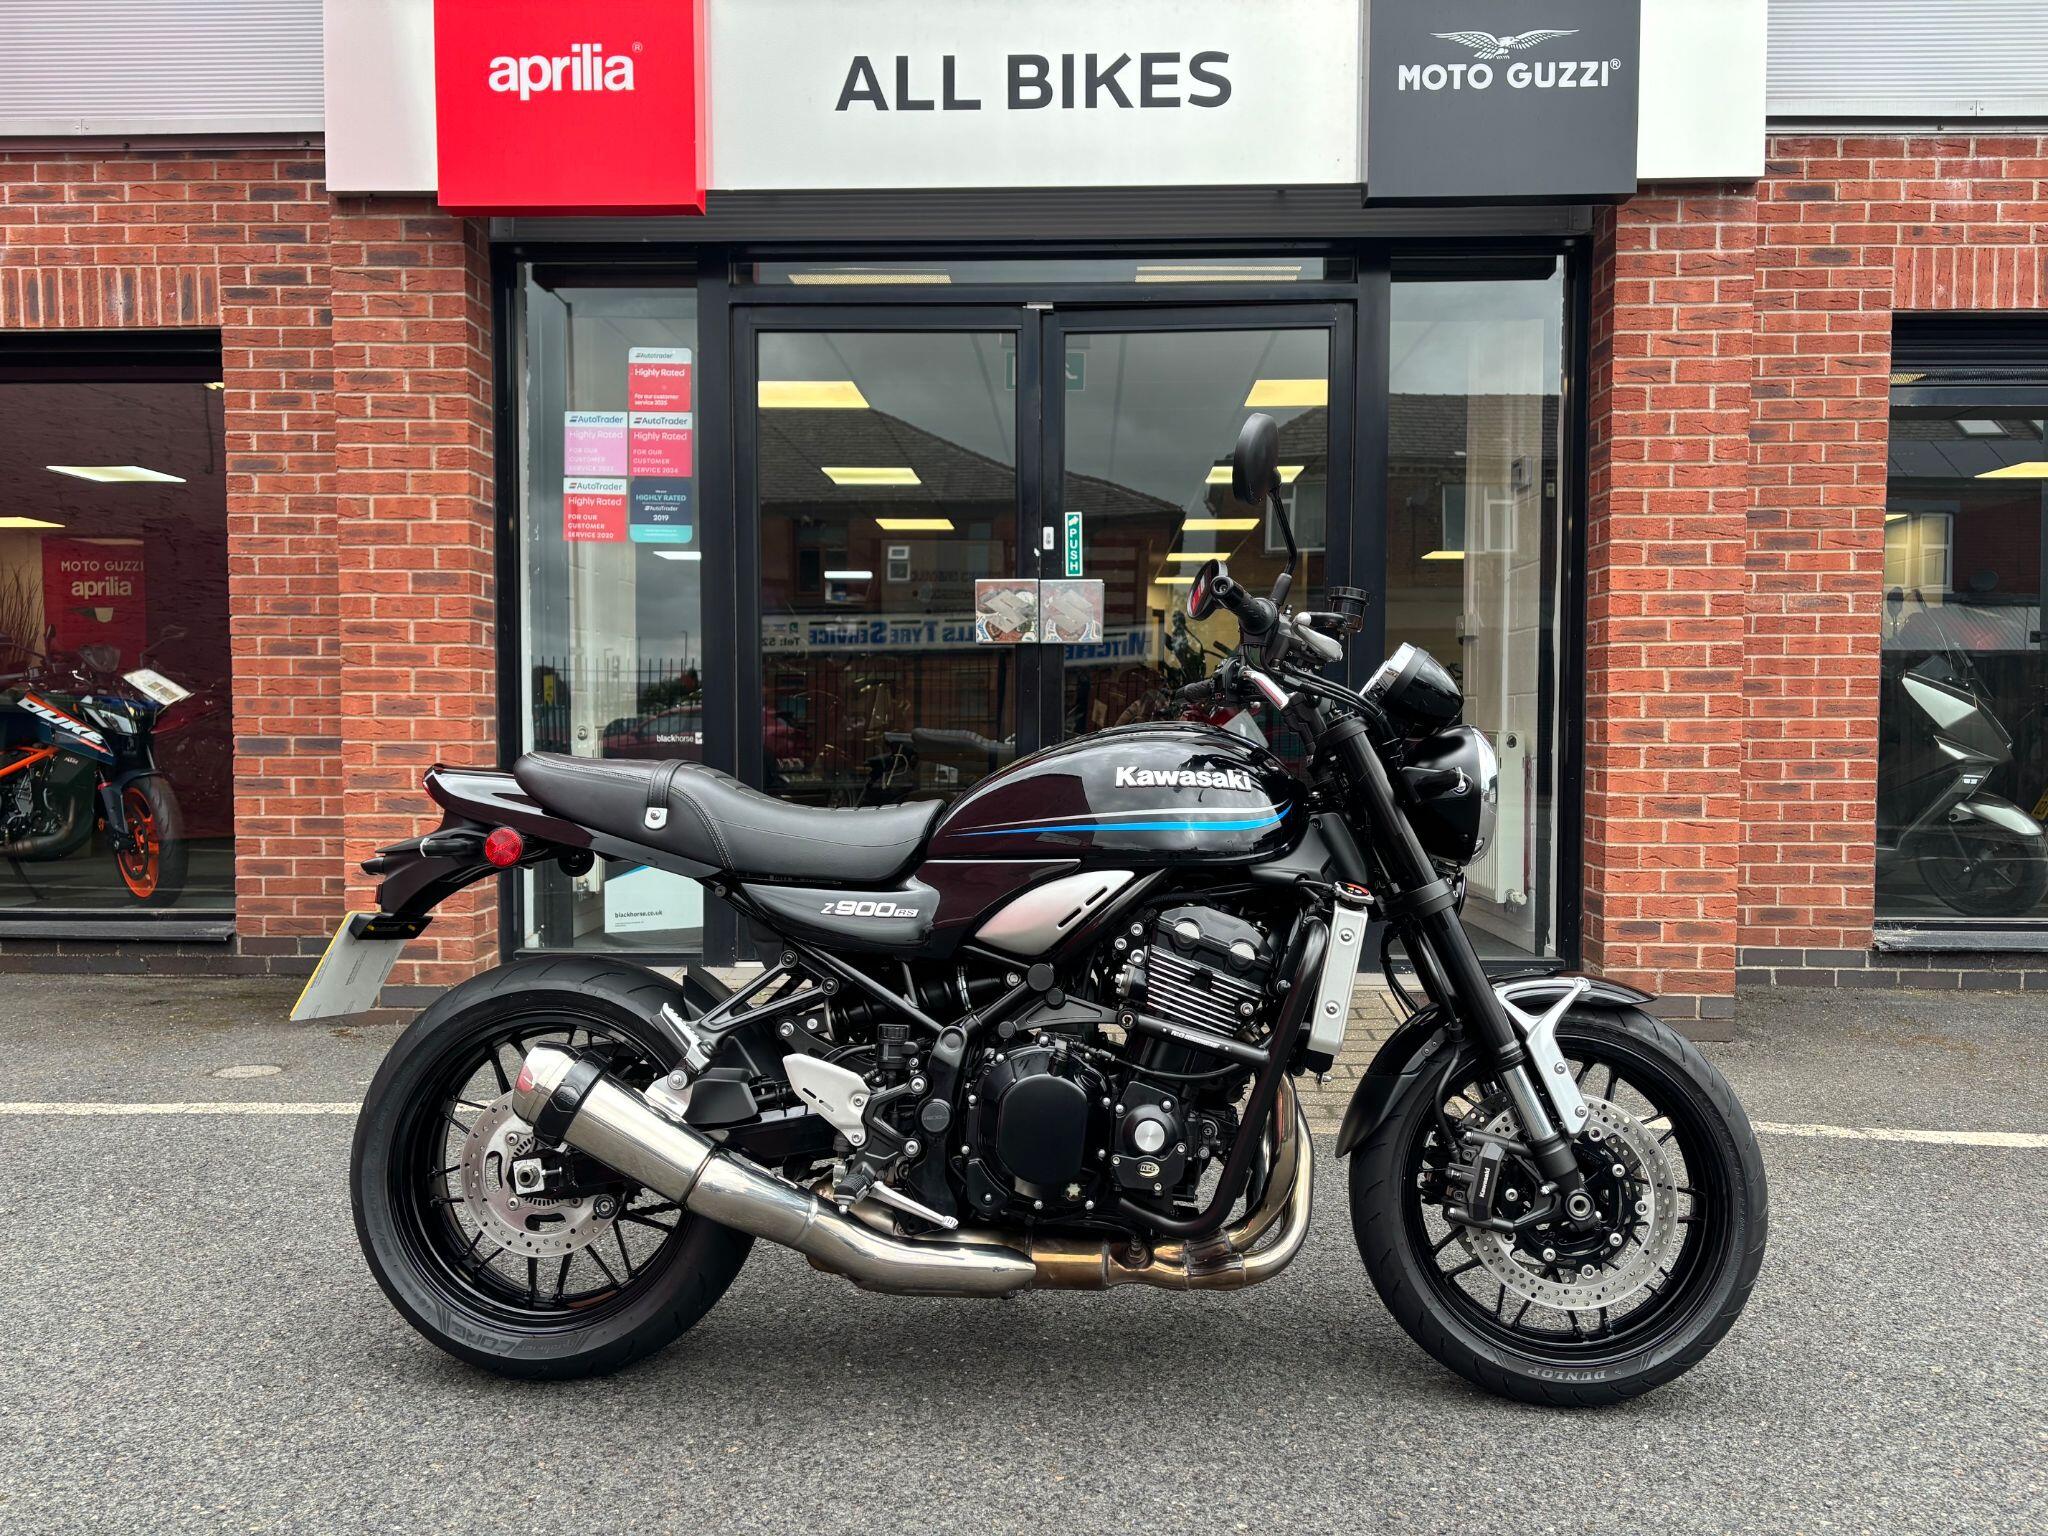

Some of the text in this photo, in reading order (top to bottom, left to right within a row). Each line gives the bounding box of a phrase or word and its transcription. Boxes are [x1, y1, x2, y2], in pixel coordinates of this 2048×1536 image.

[487, 43, 635, 101] aprilia
[1398, 60, 1609, 91] MOTO GUZZI
[834, 50, 1233, 111] ALL BIKES
[634, 368, 686, 379] Highly Rated
[577, 415, 624, 425] AutoTrader
[641, 416, 688, 426] AutoTrader
[569, 431, 624, 441] Highly Rated
[633, 431, 688, 443] Highly Rated
[632, 466, 661, 474] SERVICE
[576, 482, 623, 491] AutoTrader
[568, 497, 622, 507] Highly Rated
[662, 494, 687, 502] RATED
[567, 513, 598, 521] FOR OUR
[652, 514, 670, 522] 2019
[567, 531, 596, 539] SERVICE
[1069, 528, 1079, 571] PUSH
[60, 559, 144, 572] MOTO GUZZI
[71, 576, 133, 600] aprilia
[16, 699, 105, 745] DUKE
[656, 734, 694, 743] blackhorse
[1115, 766, 1252, 792] Kawasaki
[614, 909, 663, 919] blackhorse.co.uk
[1528, 1366, 1606, 1382] DUNLOP
